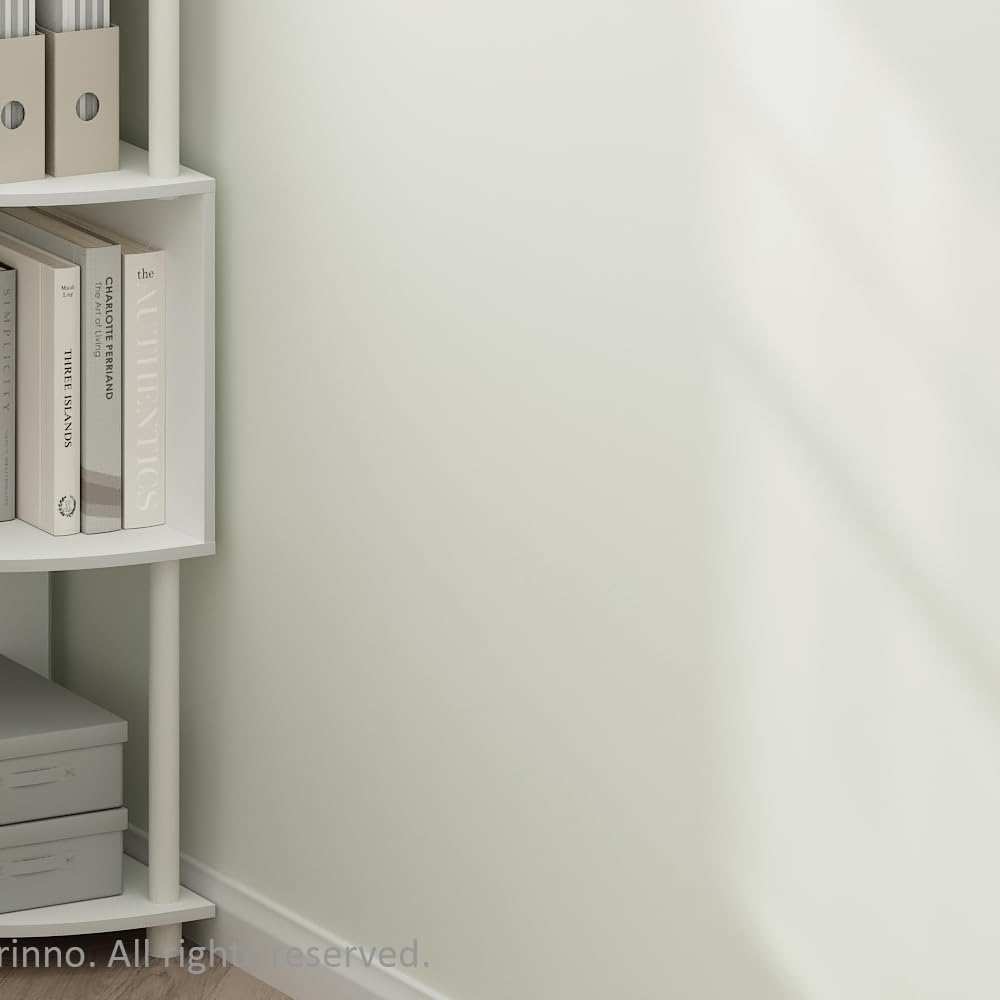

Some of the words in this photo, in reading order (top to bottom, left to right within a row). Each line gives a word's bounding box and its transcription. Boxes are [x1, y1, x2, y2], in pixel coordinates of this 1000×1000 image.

[137, 268, 155, 280] the
[94, 318, 102, 329] of
[105, 276, 113, 341] CHARLOTTE
[94, 330, 102, 358] Living
[64, 349, 73, 391] THREE
[105, 344, 113, 400] PERRIAND
[64, 395, 73, 448] ISLANDS
